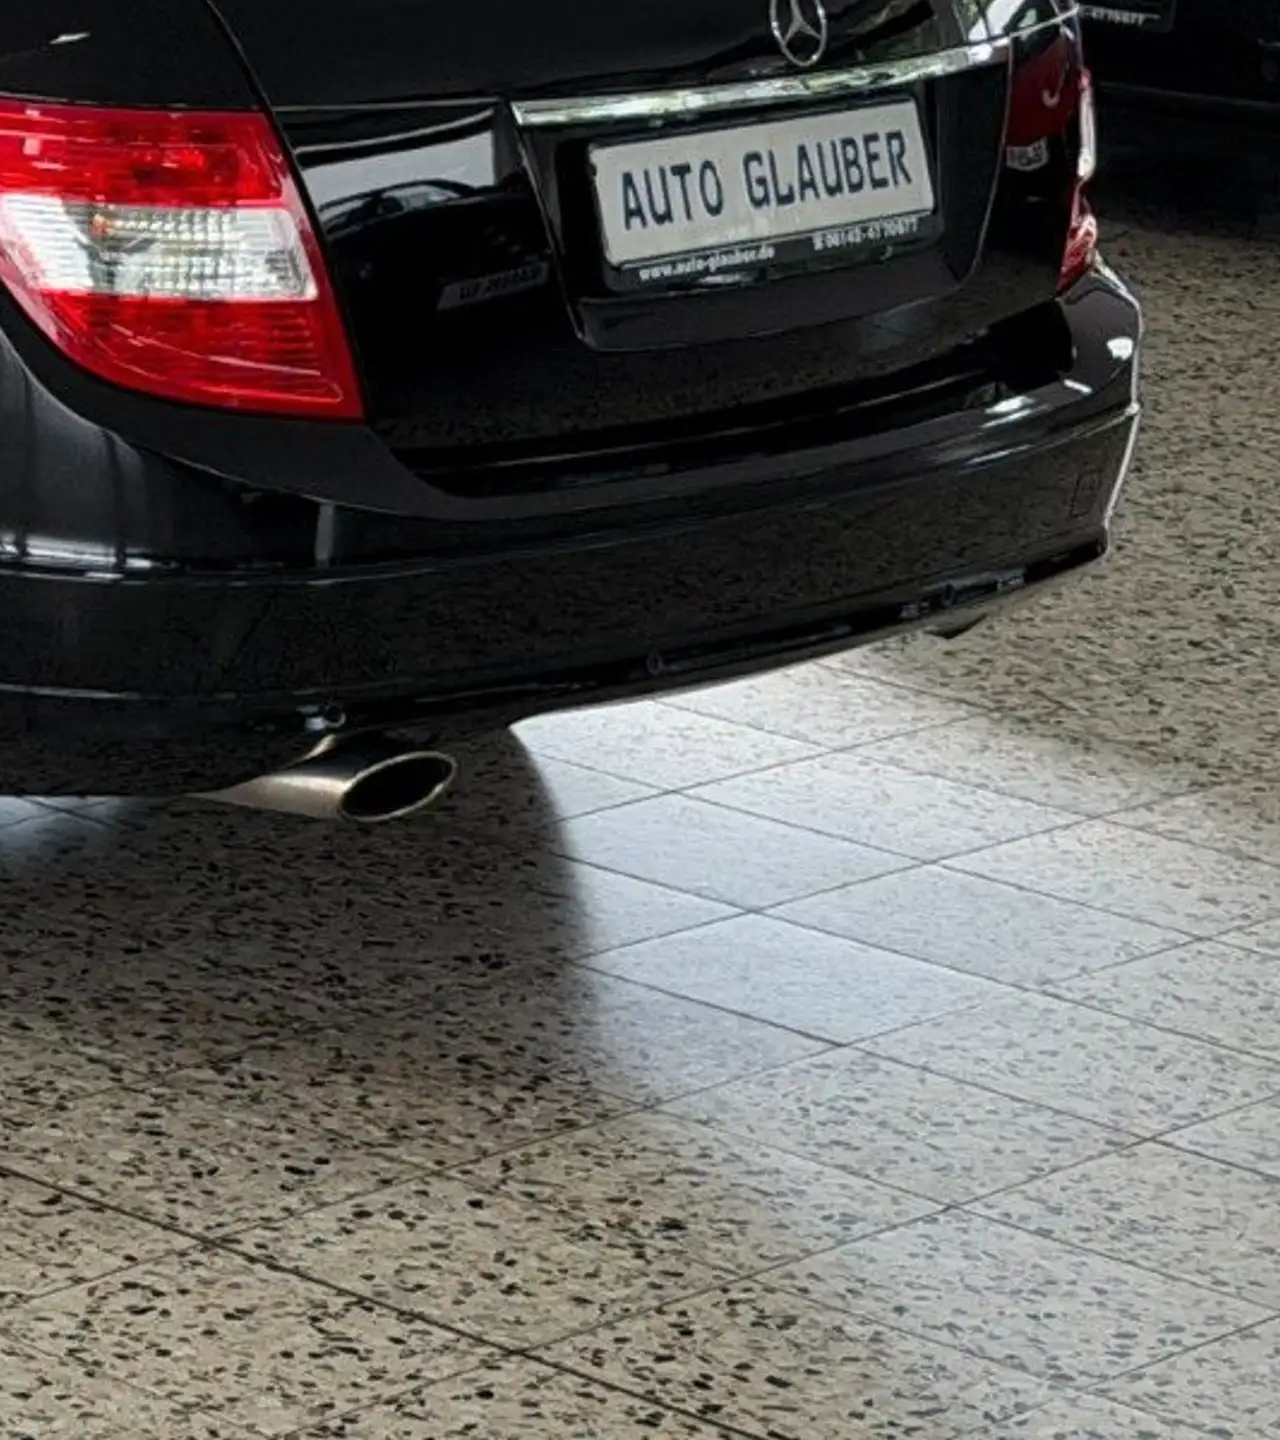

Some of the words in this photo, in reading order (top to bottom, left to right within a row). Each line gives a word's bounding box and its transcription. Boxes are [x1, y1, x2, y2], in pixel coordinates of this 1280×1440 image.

[621, 160, 725, 232] AUTO
[742, 129, 913, 209] GLAUBER
[639, 244, 776, 282] www.auto-glauber.de
